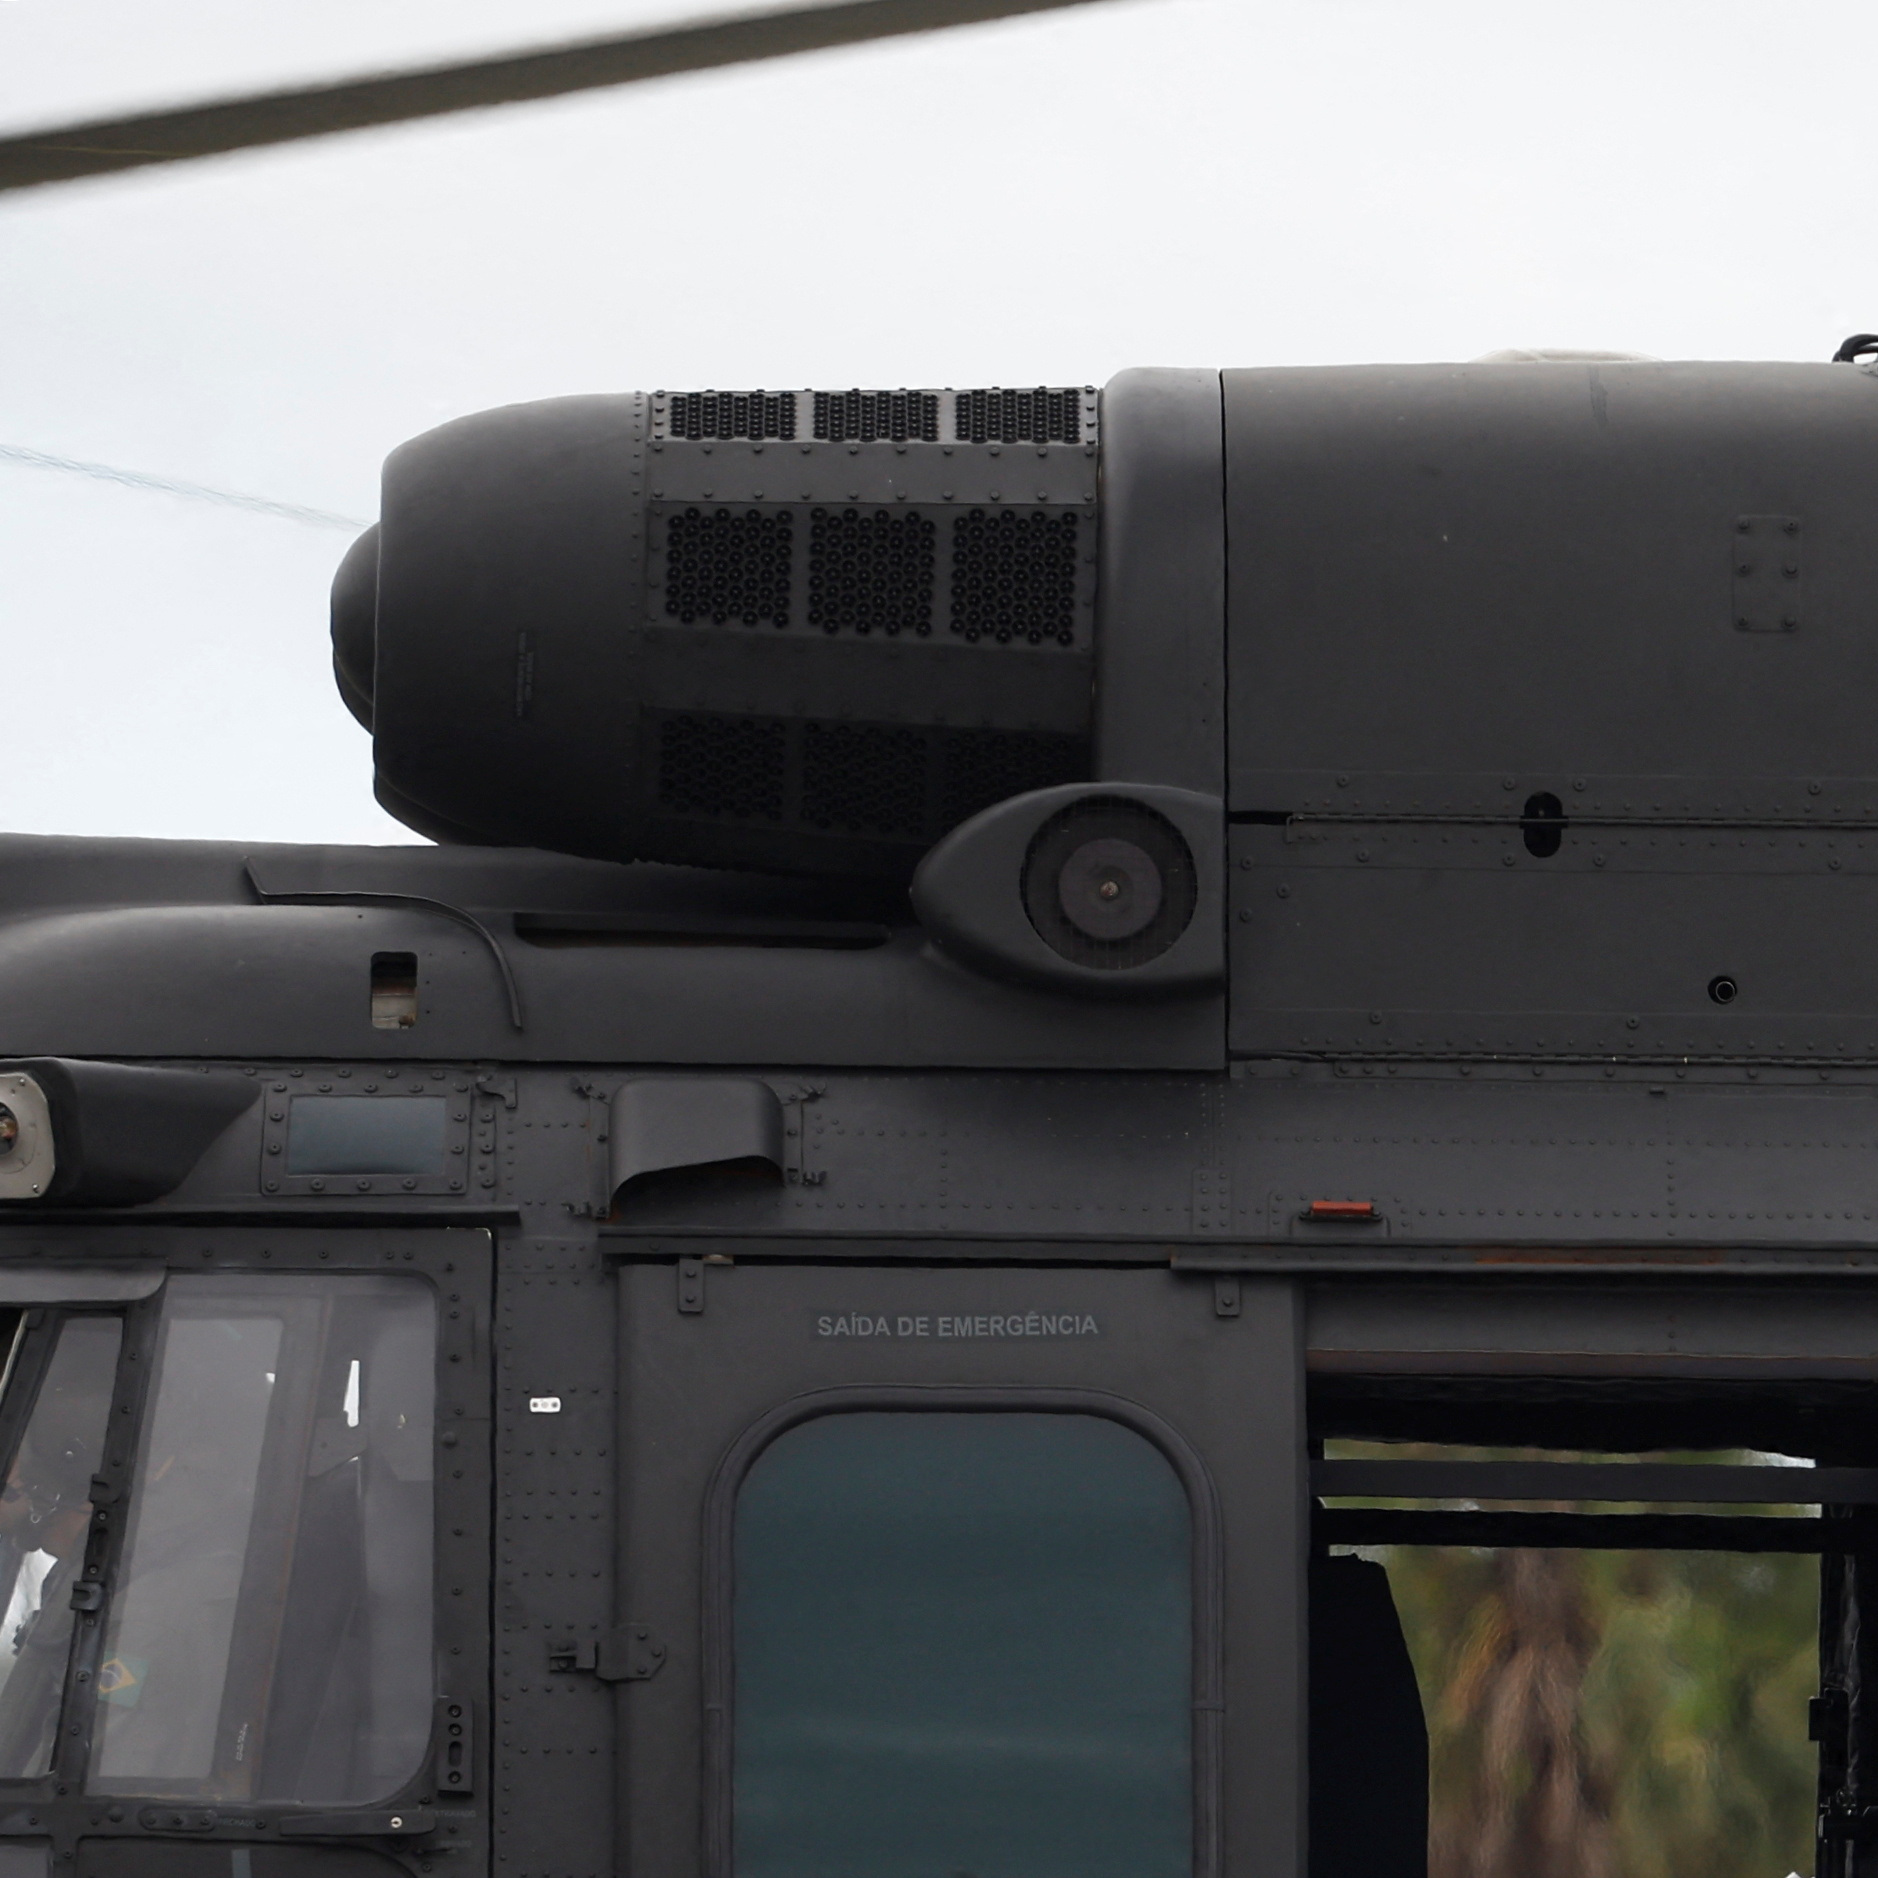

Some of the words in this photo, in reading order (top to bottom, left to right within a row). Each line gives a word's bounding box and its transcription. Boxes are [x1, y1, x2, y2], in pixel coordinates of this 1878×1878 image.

[817, 1311, 891, 1337] SAÍDA
[897, 1316, 930, 1336] DE
[938, 1310, 1099, 1337] EMERGÊNCIA
